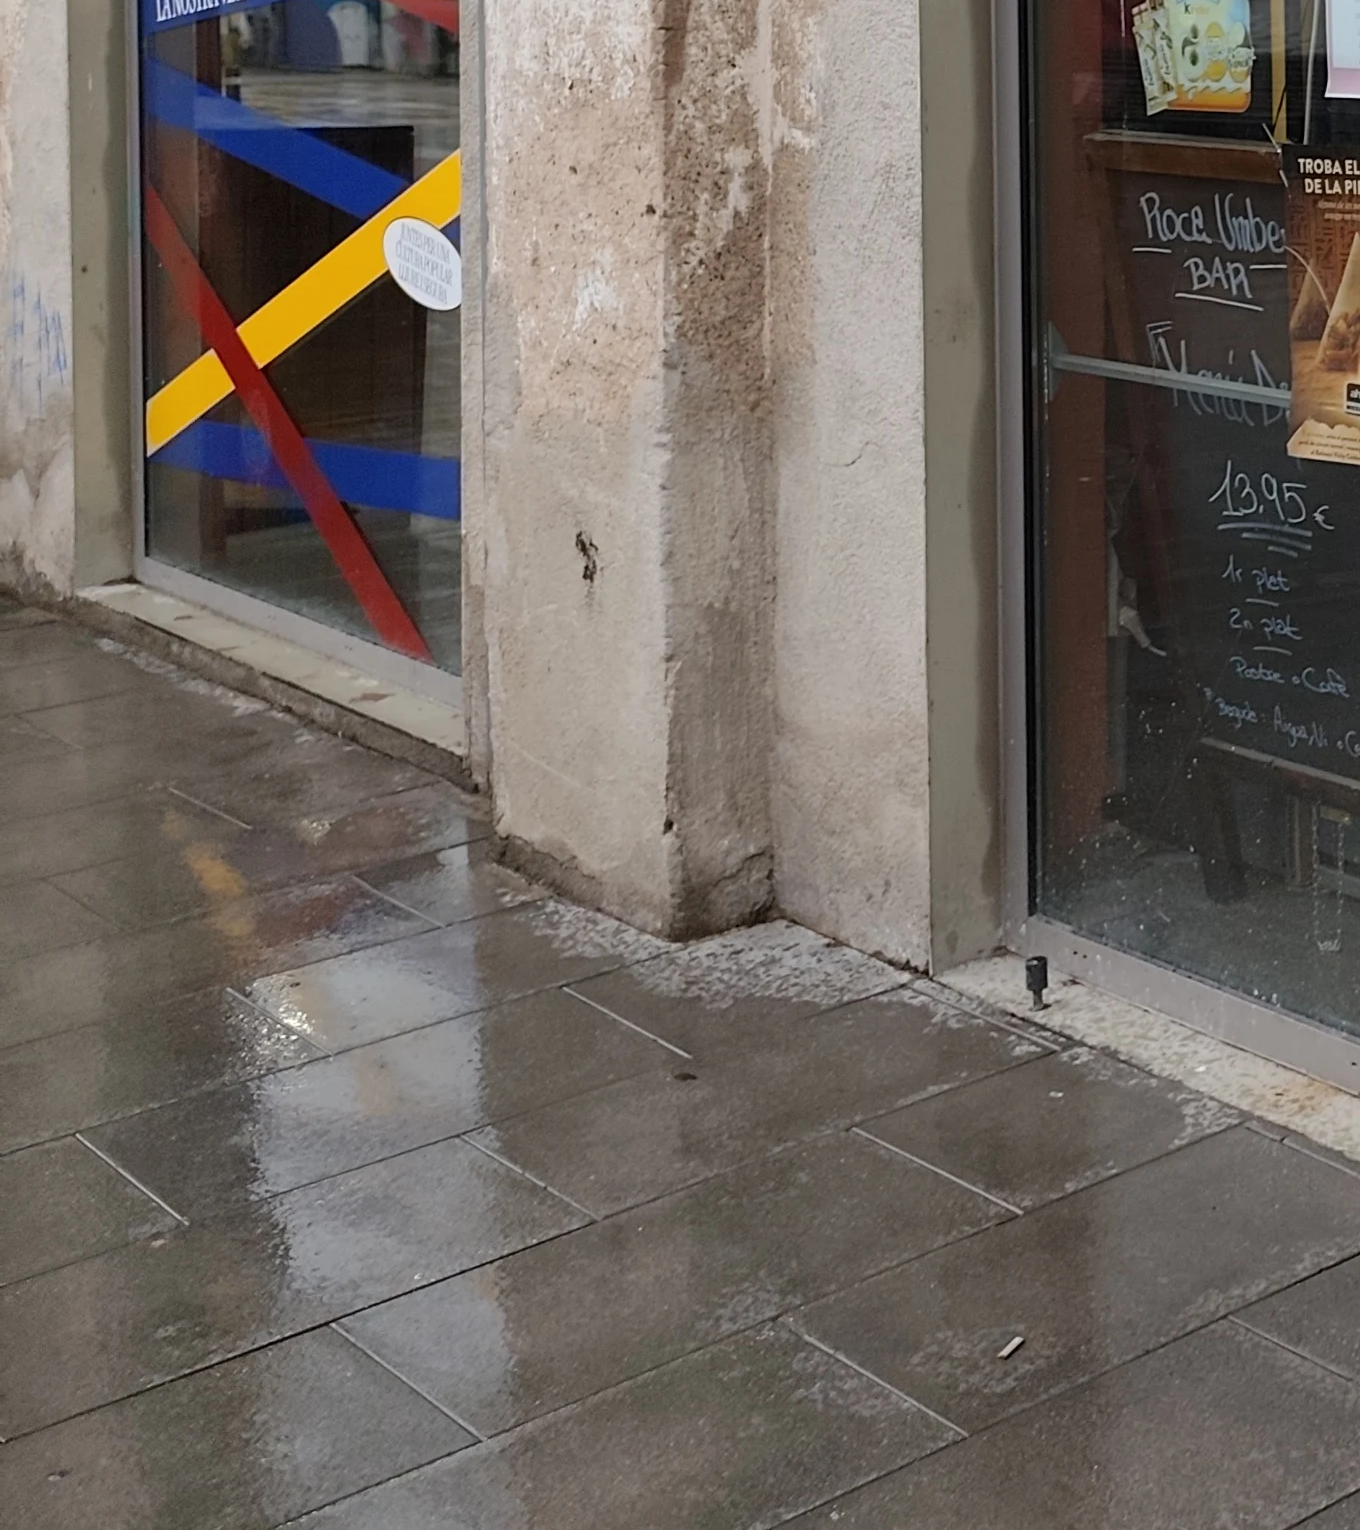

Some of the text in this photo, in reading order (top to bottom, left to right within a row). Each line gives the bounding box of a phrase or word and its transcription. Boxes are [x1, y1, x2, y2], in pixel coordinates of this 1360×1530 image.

[1297, 158, 1343, 175] TROBA
[1344, 159, 1360, 175] EL
[1304, 178, 1322, 194] DE
[1324, 179, 1342, 195] LA
[1183, 256, 1253, 299] BAR
[1312, 505, 1336, 530] €
[1251, 567, 1290, 594] plat
[1260, 615, 1303, 641] plat
